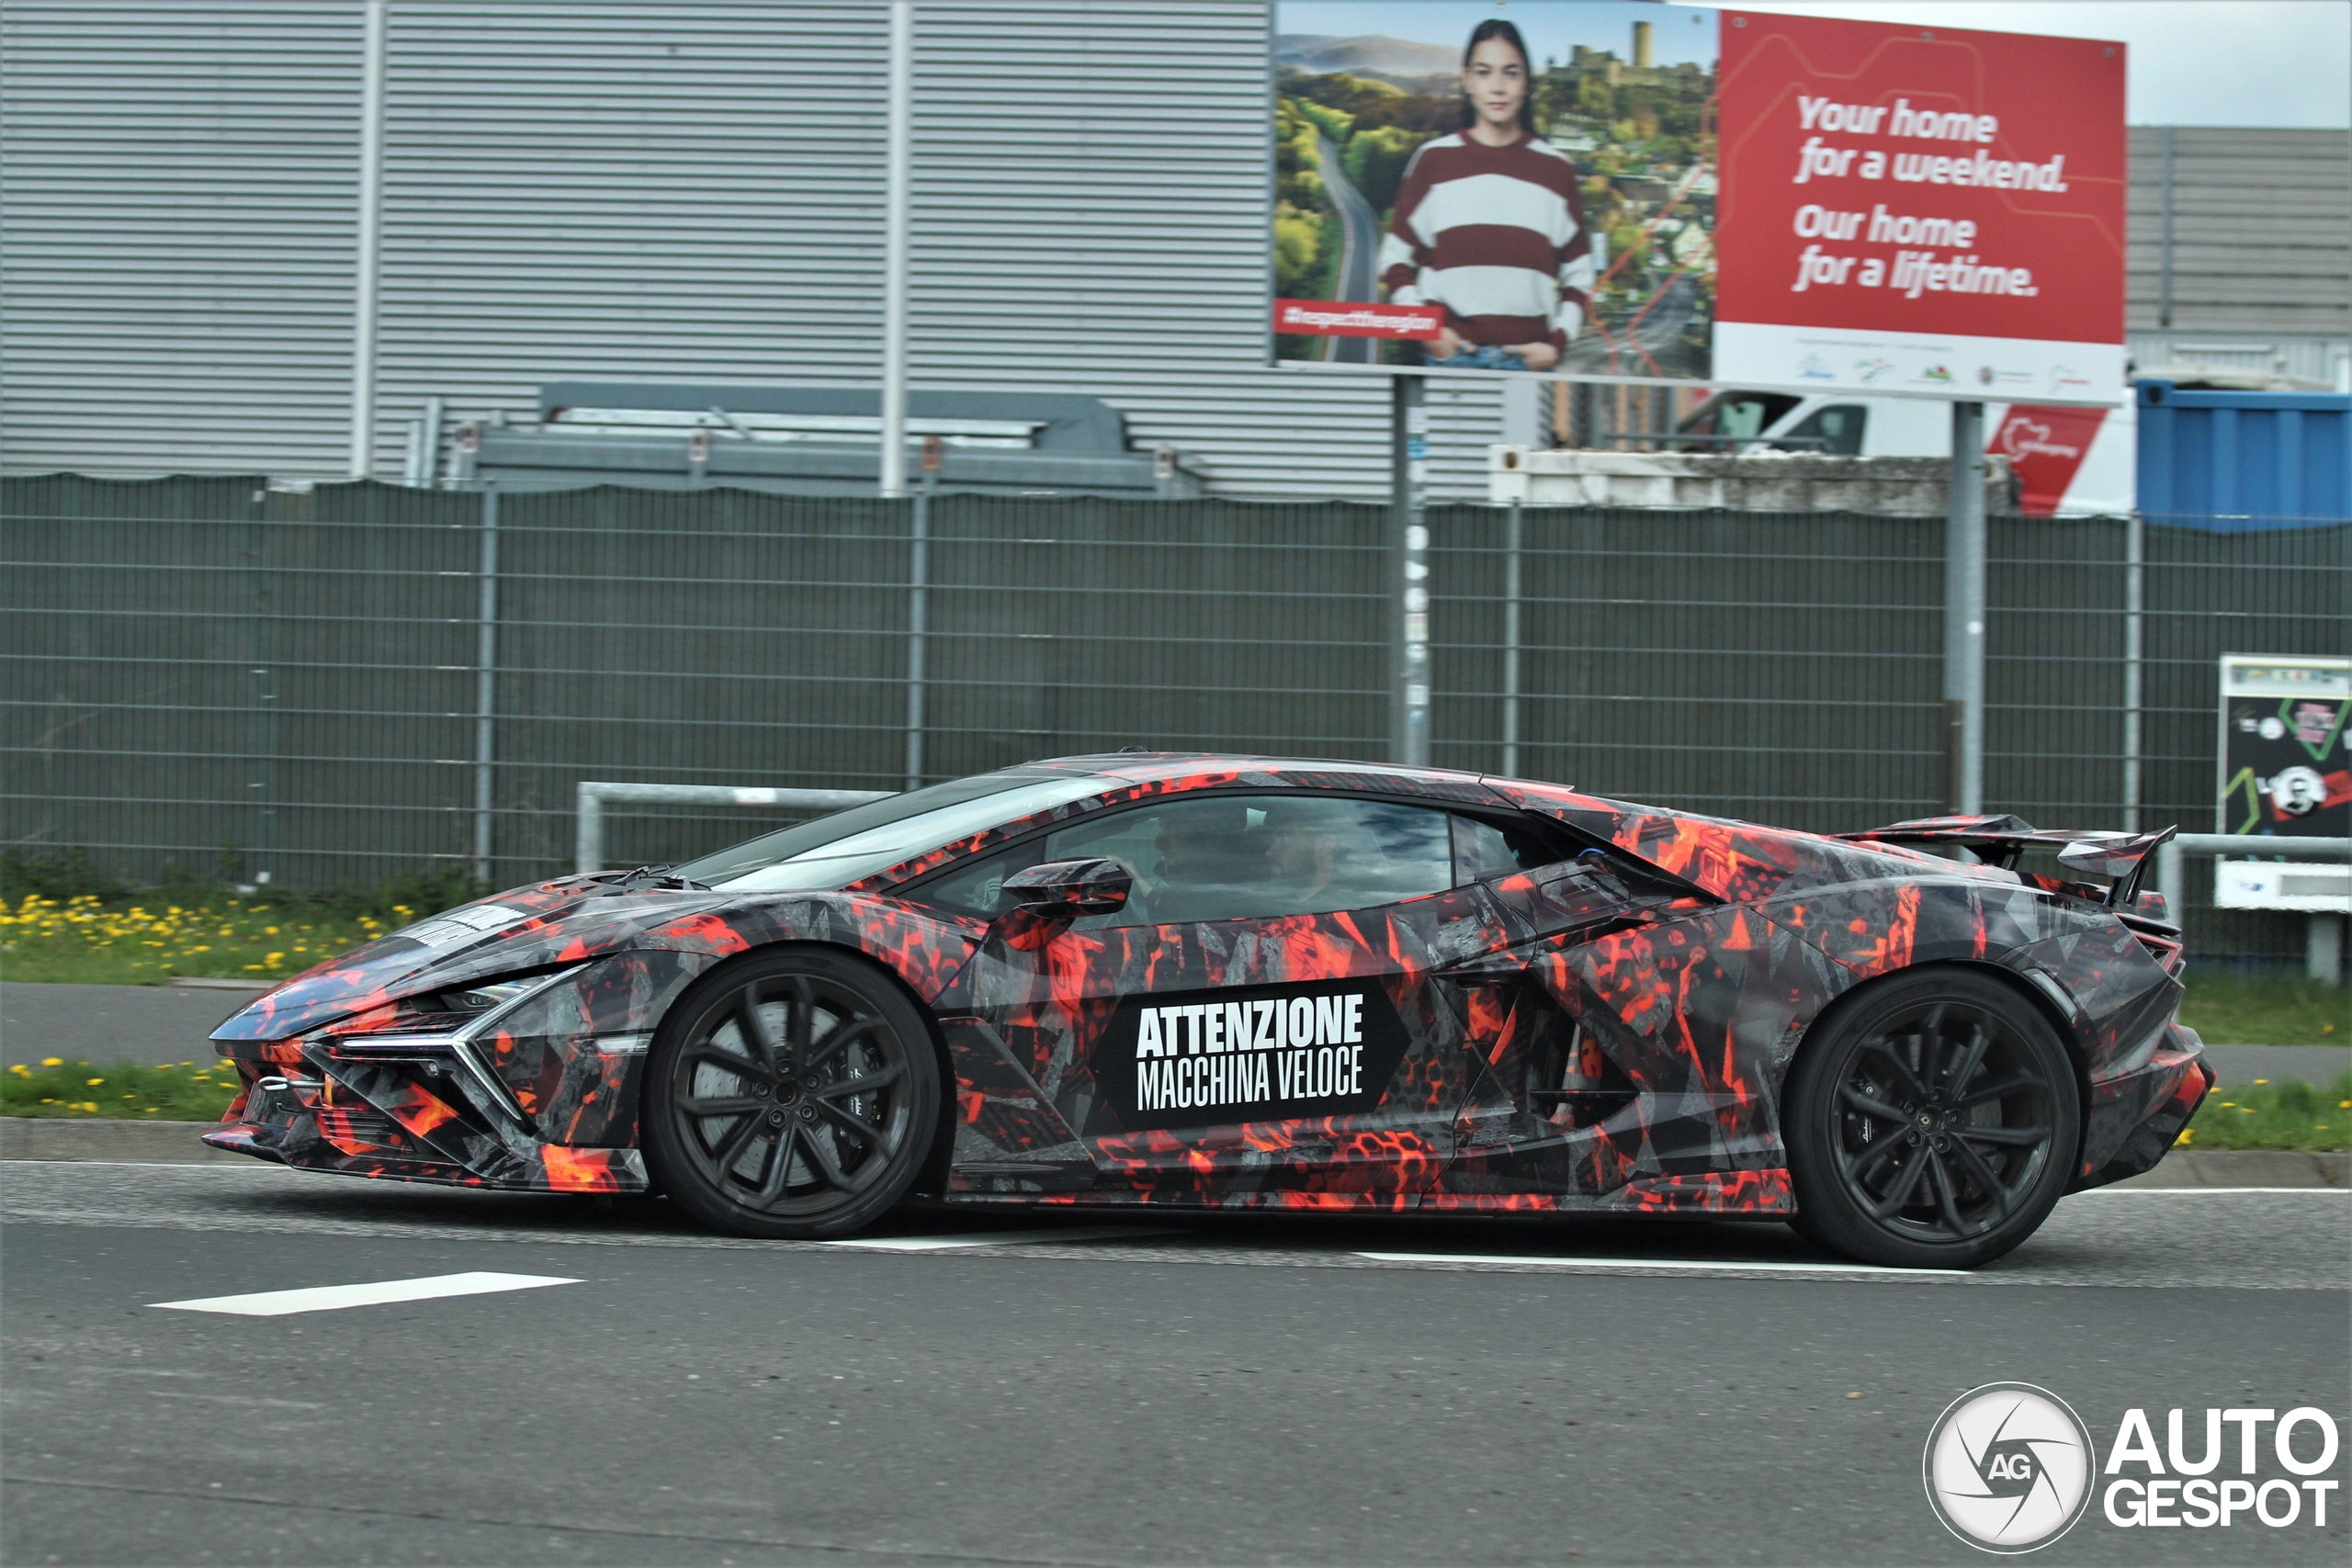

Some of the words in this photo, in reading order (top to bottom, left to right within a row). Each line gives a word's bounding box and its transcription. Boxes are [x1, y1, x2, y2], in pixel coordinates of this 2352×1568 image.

[1797, 95, 1888, 134] Your
[1888, 98, 1998, 142] home
[1792, 137, 1859, 184] for
[1859, 151, 1887, 180] a
[1892, 149, 2068, 193] weekend.
[1793, 204, 1866, 241] Our
[1866, 204, 1977, 248] home
[1791, 244, 1857, 292] for
[1857, 257, 1886, 287] a
[1889, 250, 2040, 299] lifetime.
[1136, 994, 1363, 1058] ATTENZIONE
[1137, 1052, 1271, 1111] MACCHINA
[1277, 1045, 1363, 1100] VELOCE
